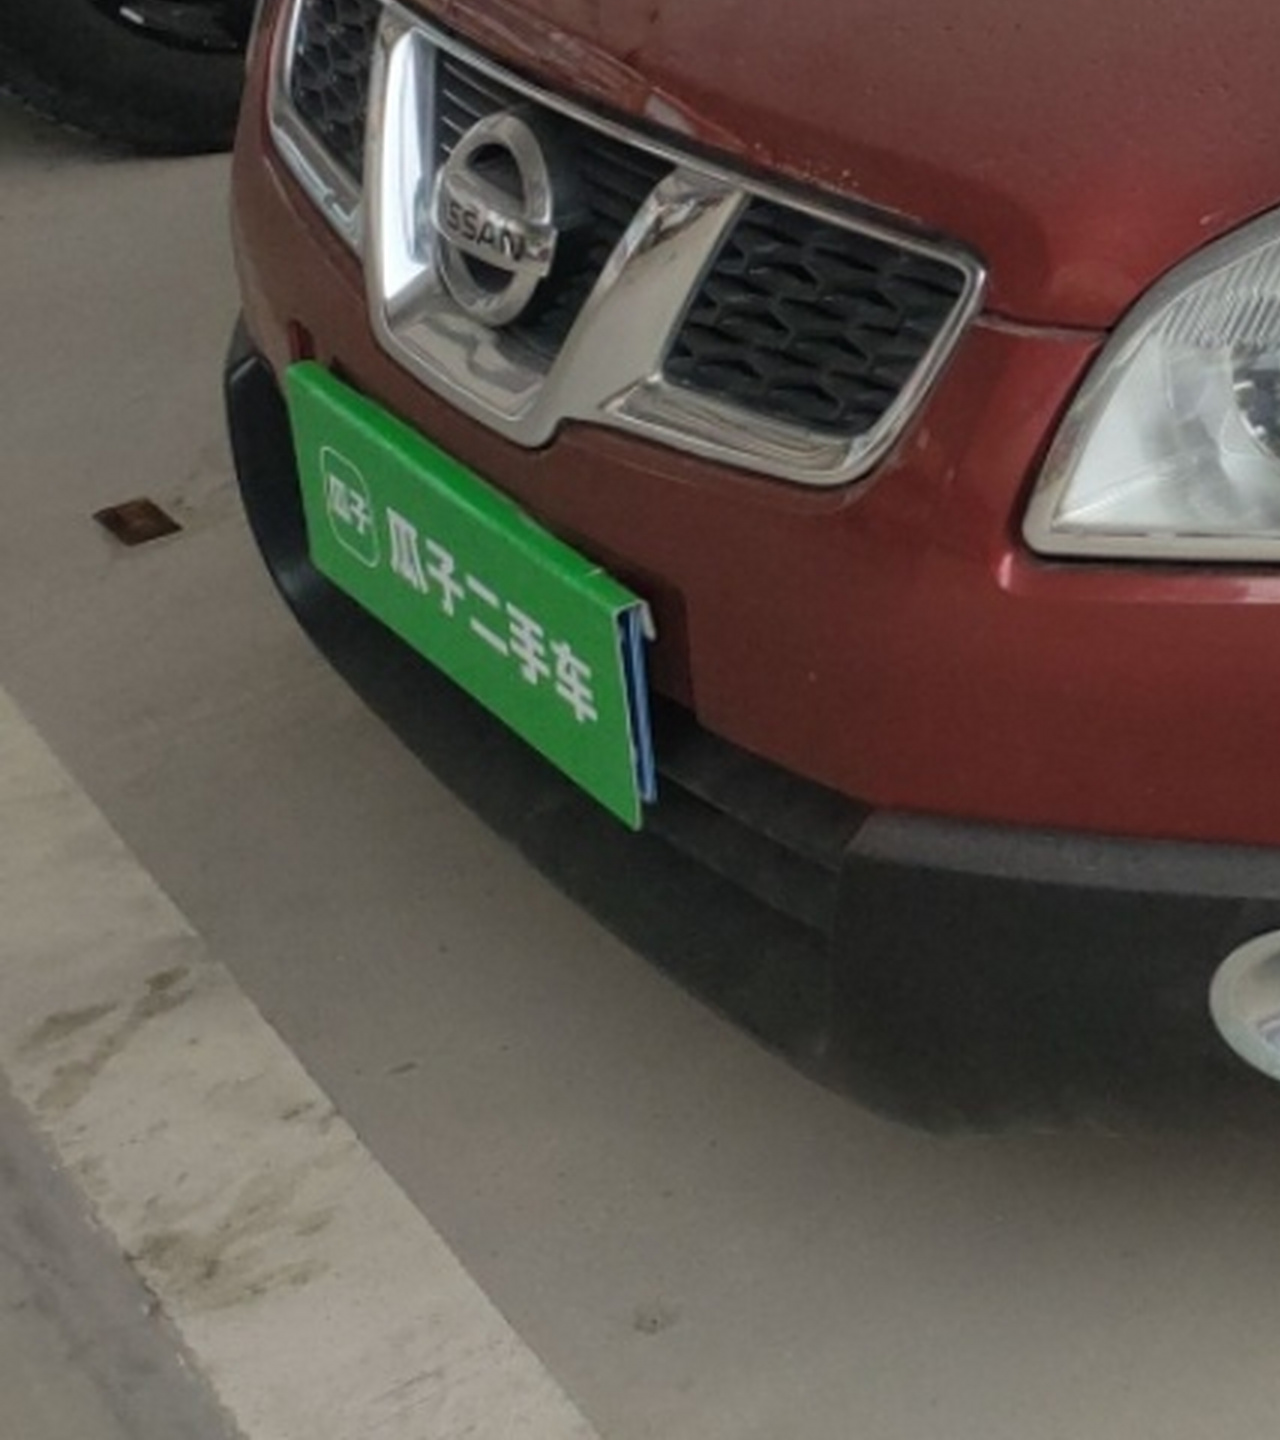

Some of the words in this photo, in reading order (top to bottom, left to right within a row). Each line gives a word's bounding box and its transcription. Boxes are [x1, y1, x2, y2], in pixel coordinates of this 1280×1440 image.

[444, 198, 526, 263] SSAN
[327, 472, 371, 535] 瓜子
[386, 505, 598, 723] 瓜子二手车
